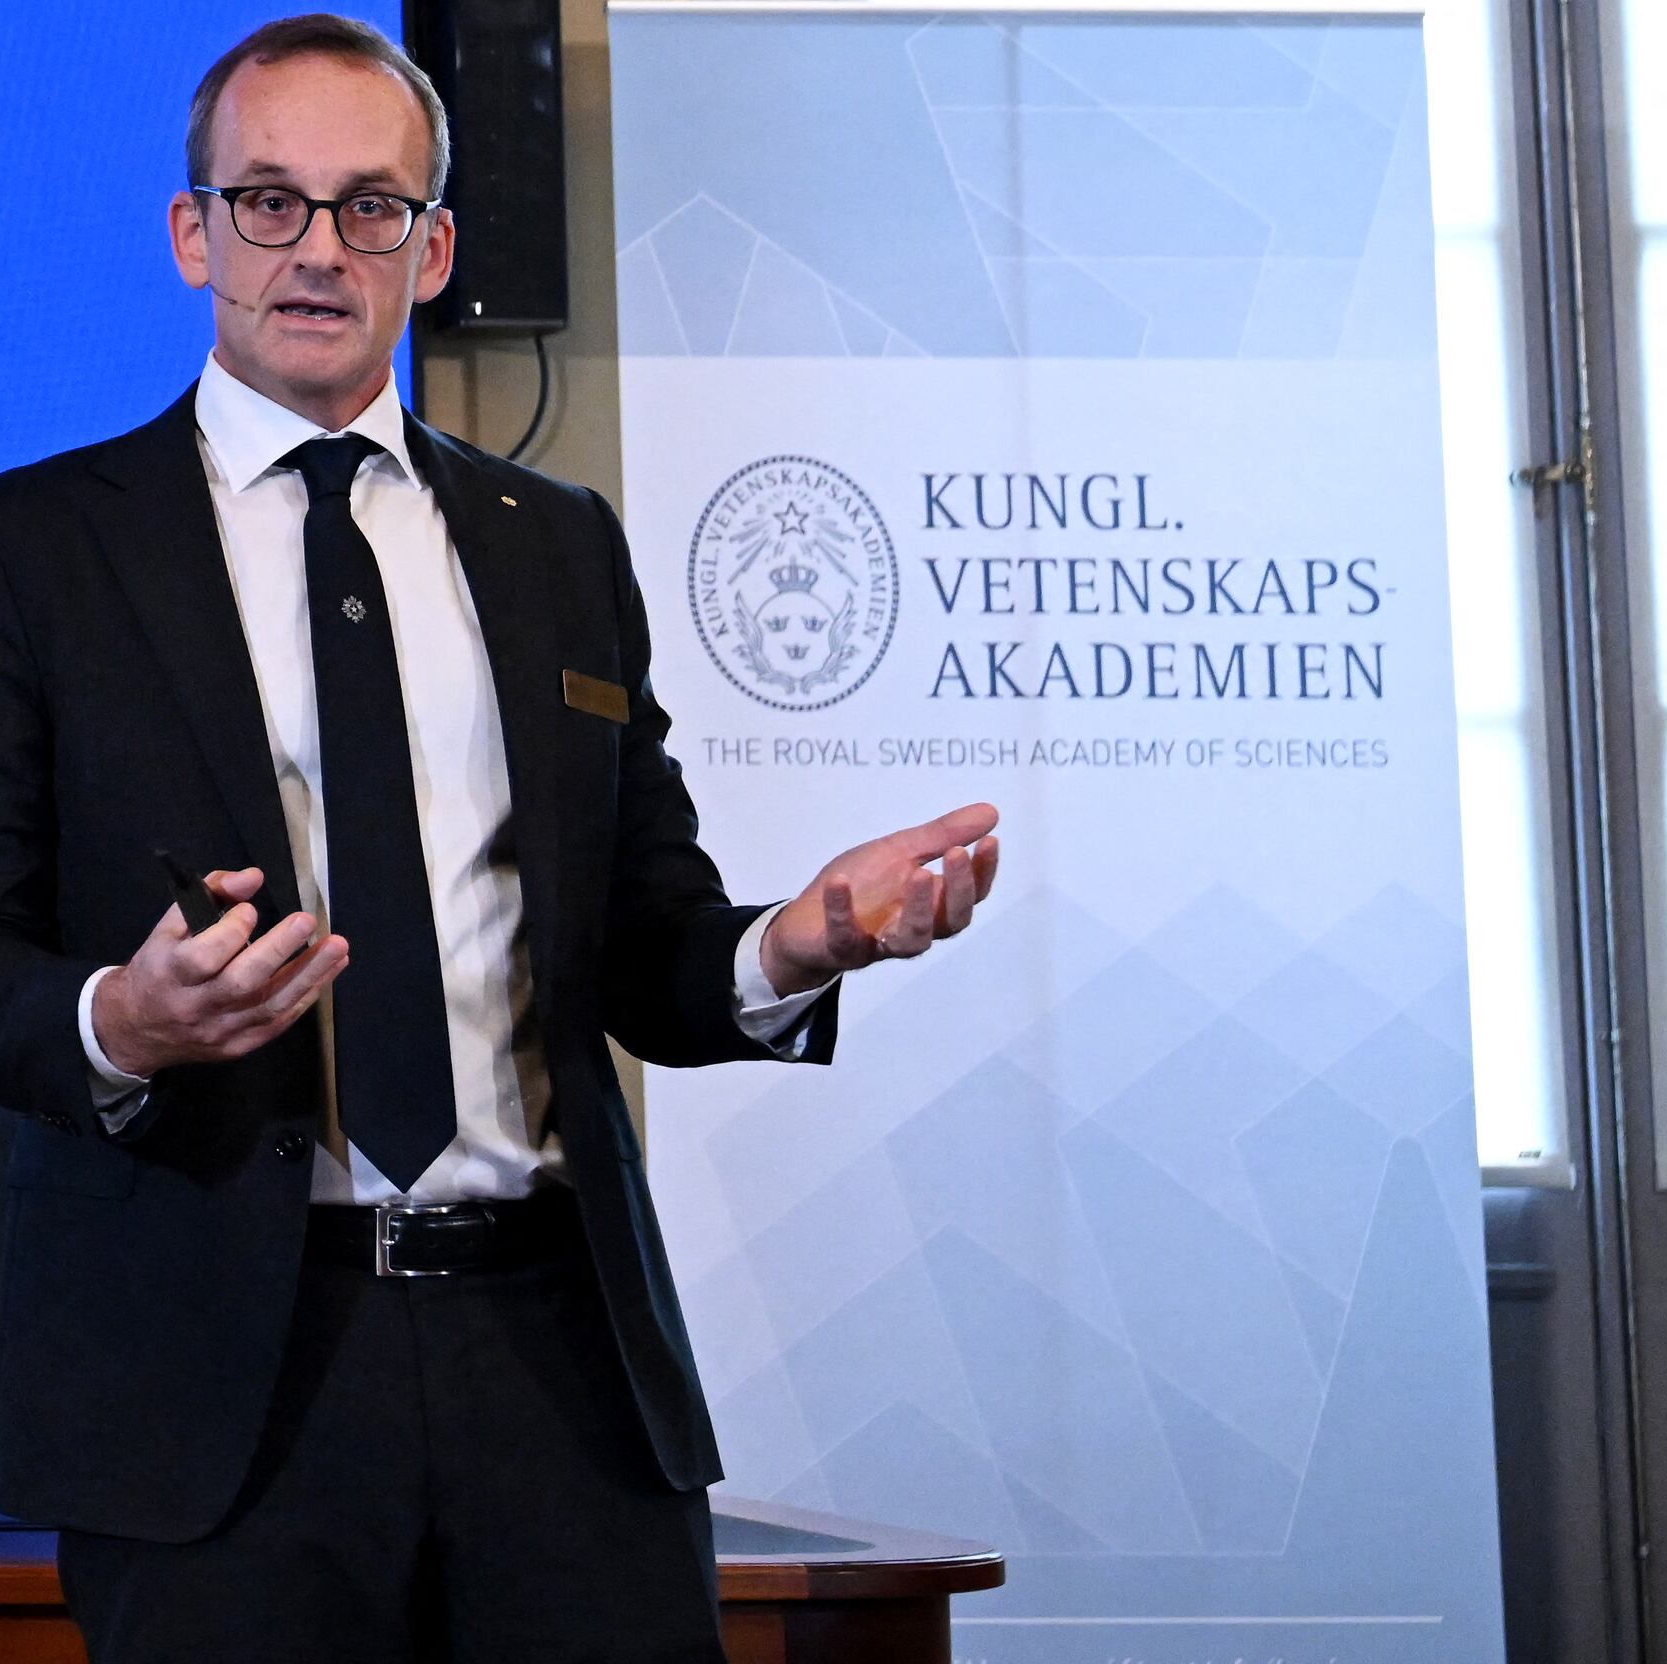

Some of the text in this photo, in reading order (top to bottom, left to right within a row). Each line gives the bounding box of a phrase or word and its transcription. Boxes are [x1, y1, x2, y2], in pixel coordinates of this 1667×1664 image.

[920, 471, 1185, 532] KUNGL.
[919, 555, 1399, 619] VETENSKAPS-
[927, 640, 1385, 702] AKADEMIEN
[701, 737, 1389, 768] THE ROYAL SWEDISH ACADEMY OF SCIENCES
